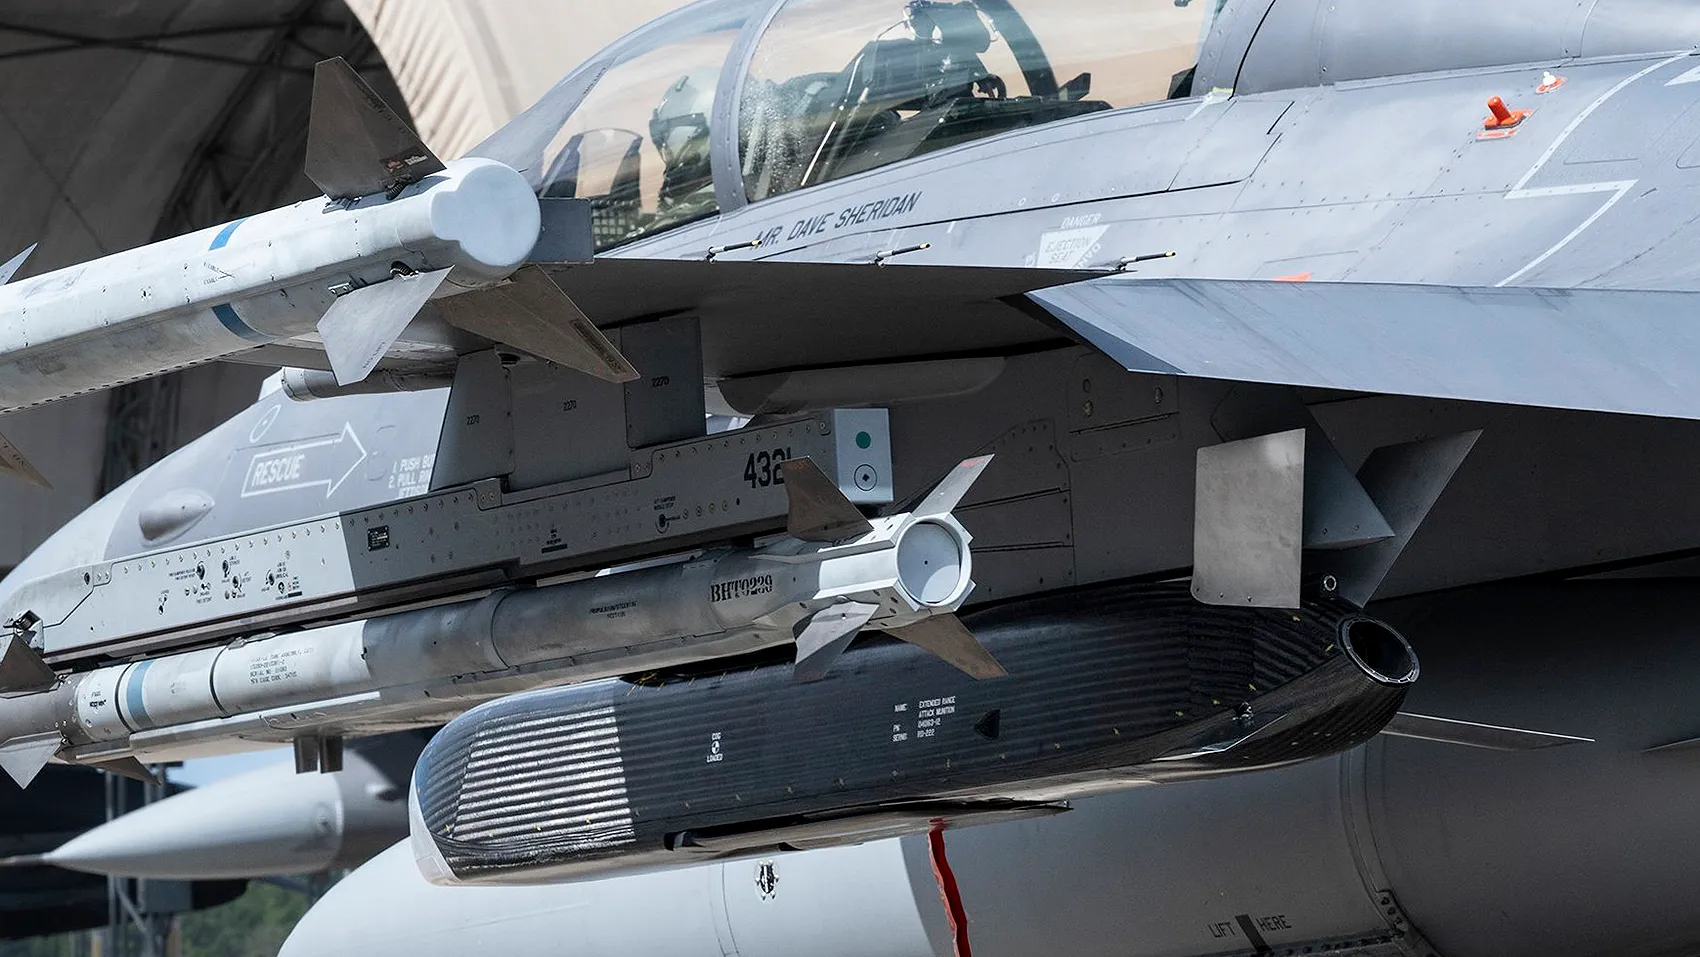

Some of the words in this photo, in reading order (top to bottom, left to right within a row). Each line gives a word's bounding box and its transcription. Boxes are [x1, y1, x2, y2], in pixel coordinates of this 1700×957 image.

[787, 212, 835, 241] DAVE
[835, 190, 922, 229] SHERIDAN
[1060, 212, 1102, 229] DANGER
[651, 375, 670, 388] 2270
[562, 400, 578, 412] 2270
[466, 414, 481, 426] 2270
[251, 453, 305, 487] RESCUE
[399, 456, 421, 472] PUSH
[397, 471, 417, 488] PULL
[918, 698, 941, 709] EXTENDED
[941, 695, 956, 705] RANGE
[918, 709, 935, 718] ATTACK
[936, 705, 956, 716] MUNITION
[1207, 922, 1236, 938] LIFT
[1255, 914, 1292, 933] HERE
